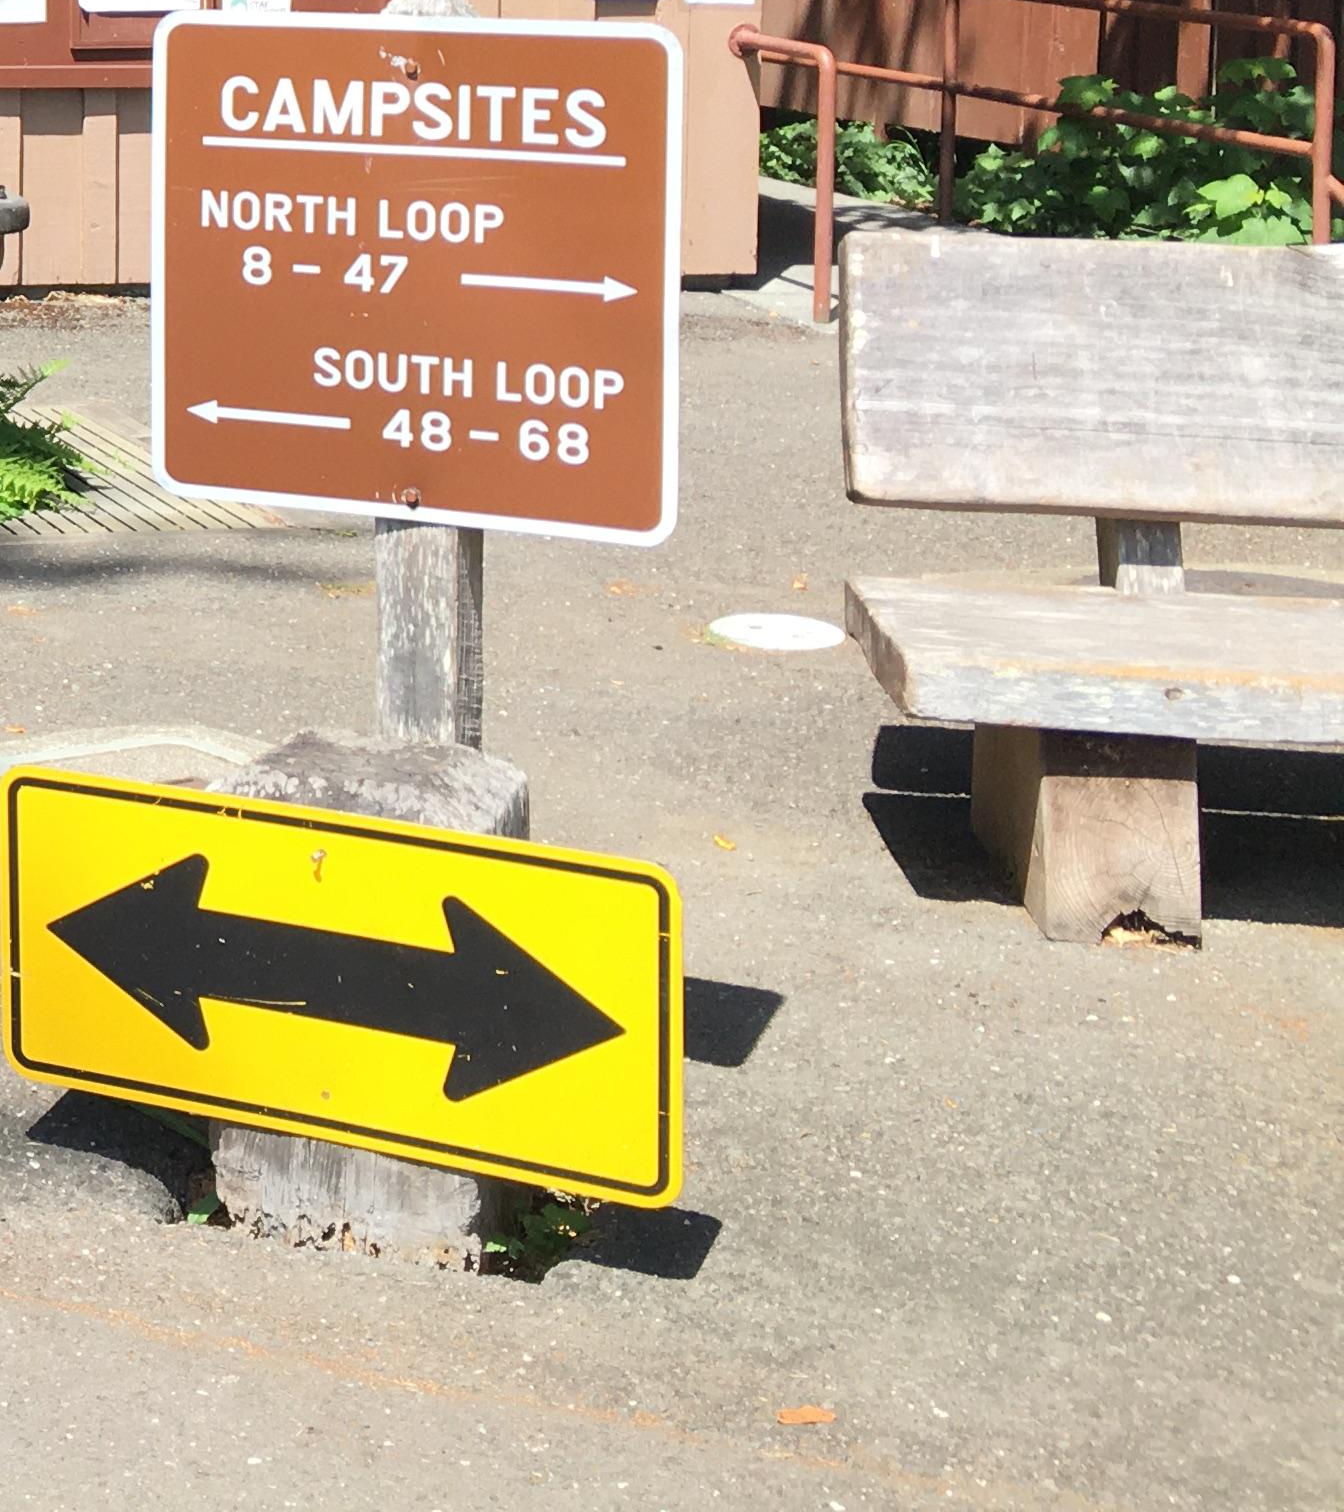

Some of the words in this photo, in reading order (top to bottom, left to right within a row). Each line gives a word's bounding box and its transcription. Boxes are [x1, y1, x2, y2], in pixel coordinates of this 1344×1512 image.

[219, 75, 607, 149] CAMPSITES
[200, 189, 357, 236] NORTH
[377, 198, 505, 244] LOOP
[242, 246, 272, 286] 8
[344, 254, 409, 294] 47
[312, 347, 473, 398] SOUTH
[495, 360, 625, 411] LOOP
[382, 408, 452, 452] 48
[519, 419, 590, 466] 68
